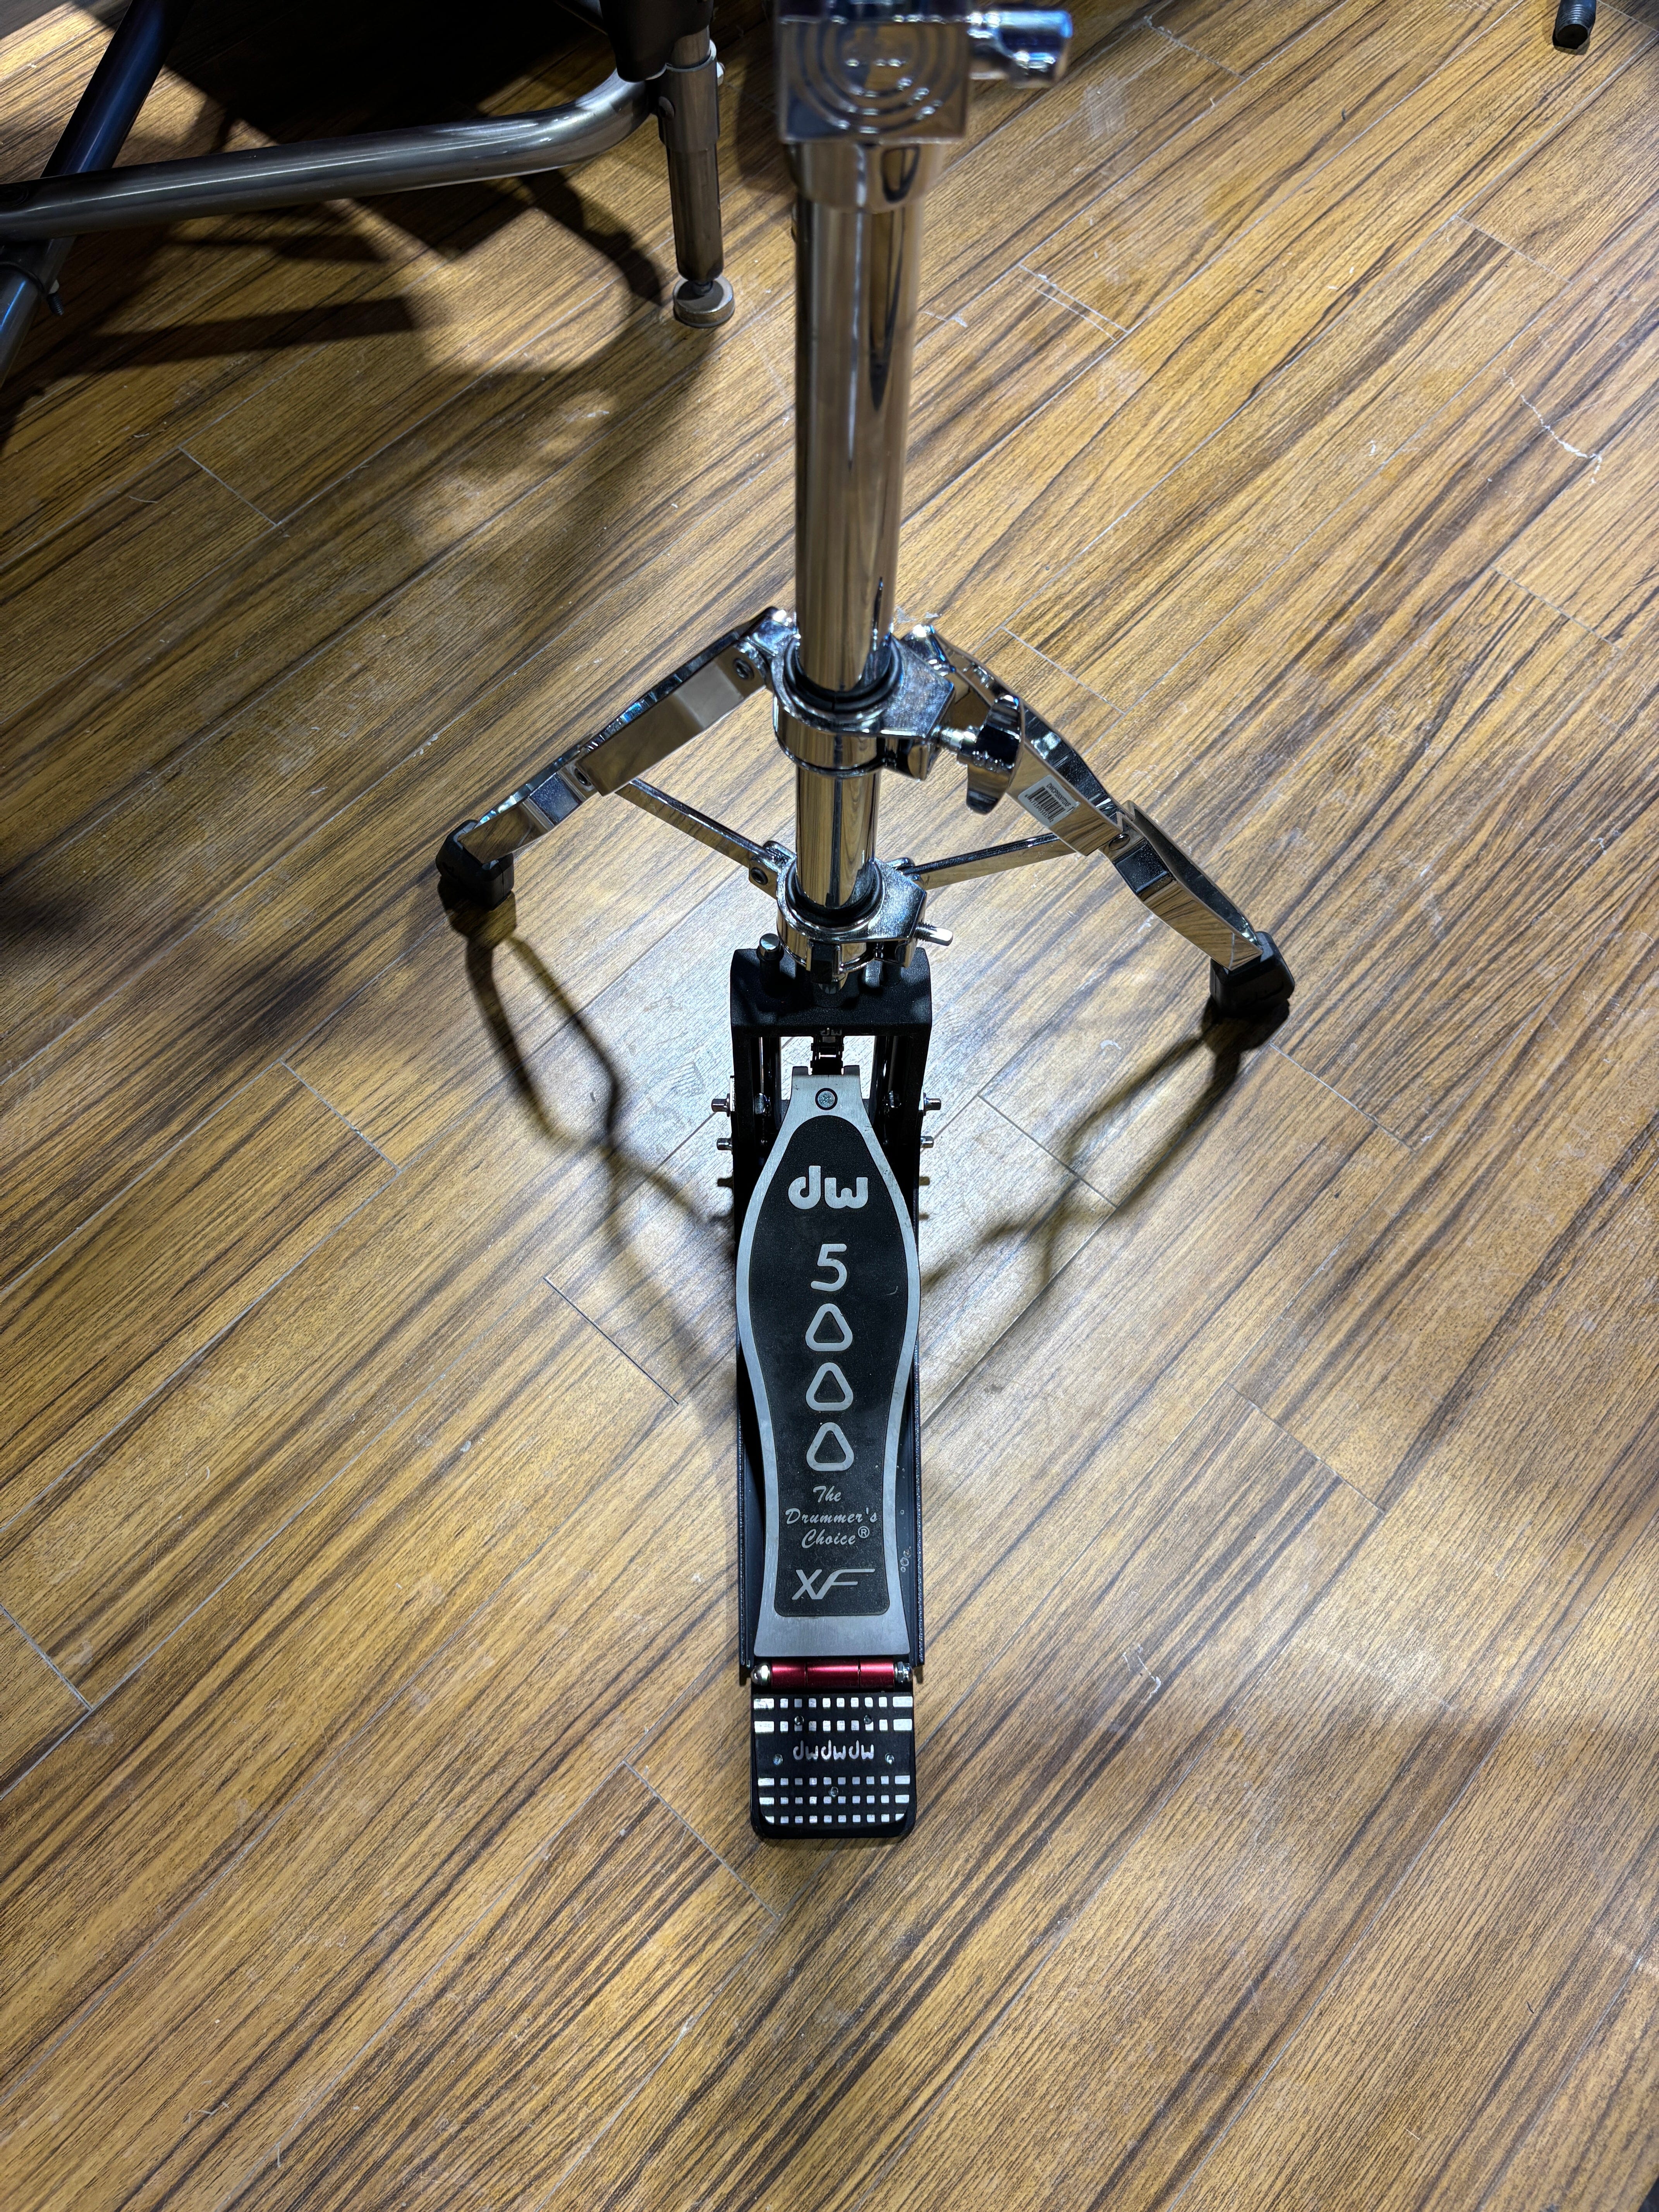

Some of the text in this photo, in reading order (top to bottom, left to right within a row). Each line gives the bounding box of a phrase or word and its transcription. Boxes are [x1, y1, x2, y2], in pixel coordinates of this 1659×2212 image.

[788, 1165, 869, 1210] dw
[812, 1486, 842, 1503] The
[785, 1507, 878, 1525] Drummer's
[791, 1568, 876, 1600] XF
[793, 1740, 874, 1760] dwdwdw
